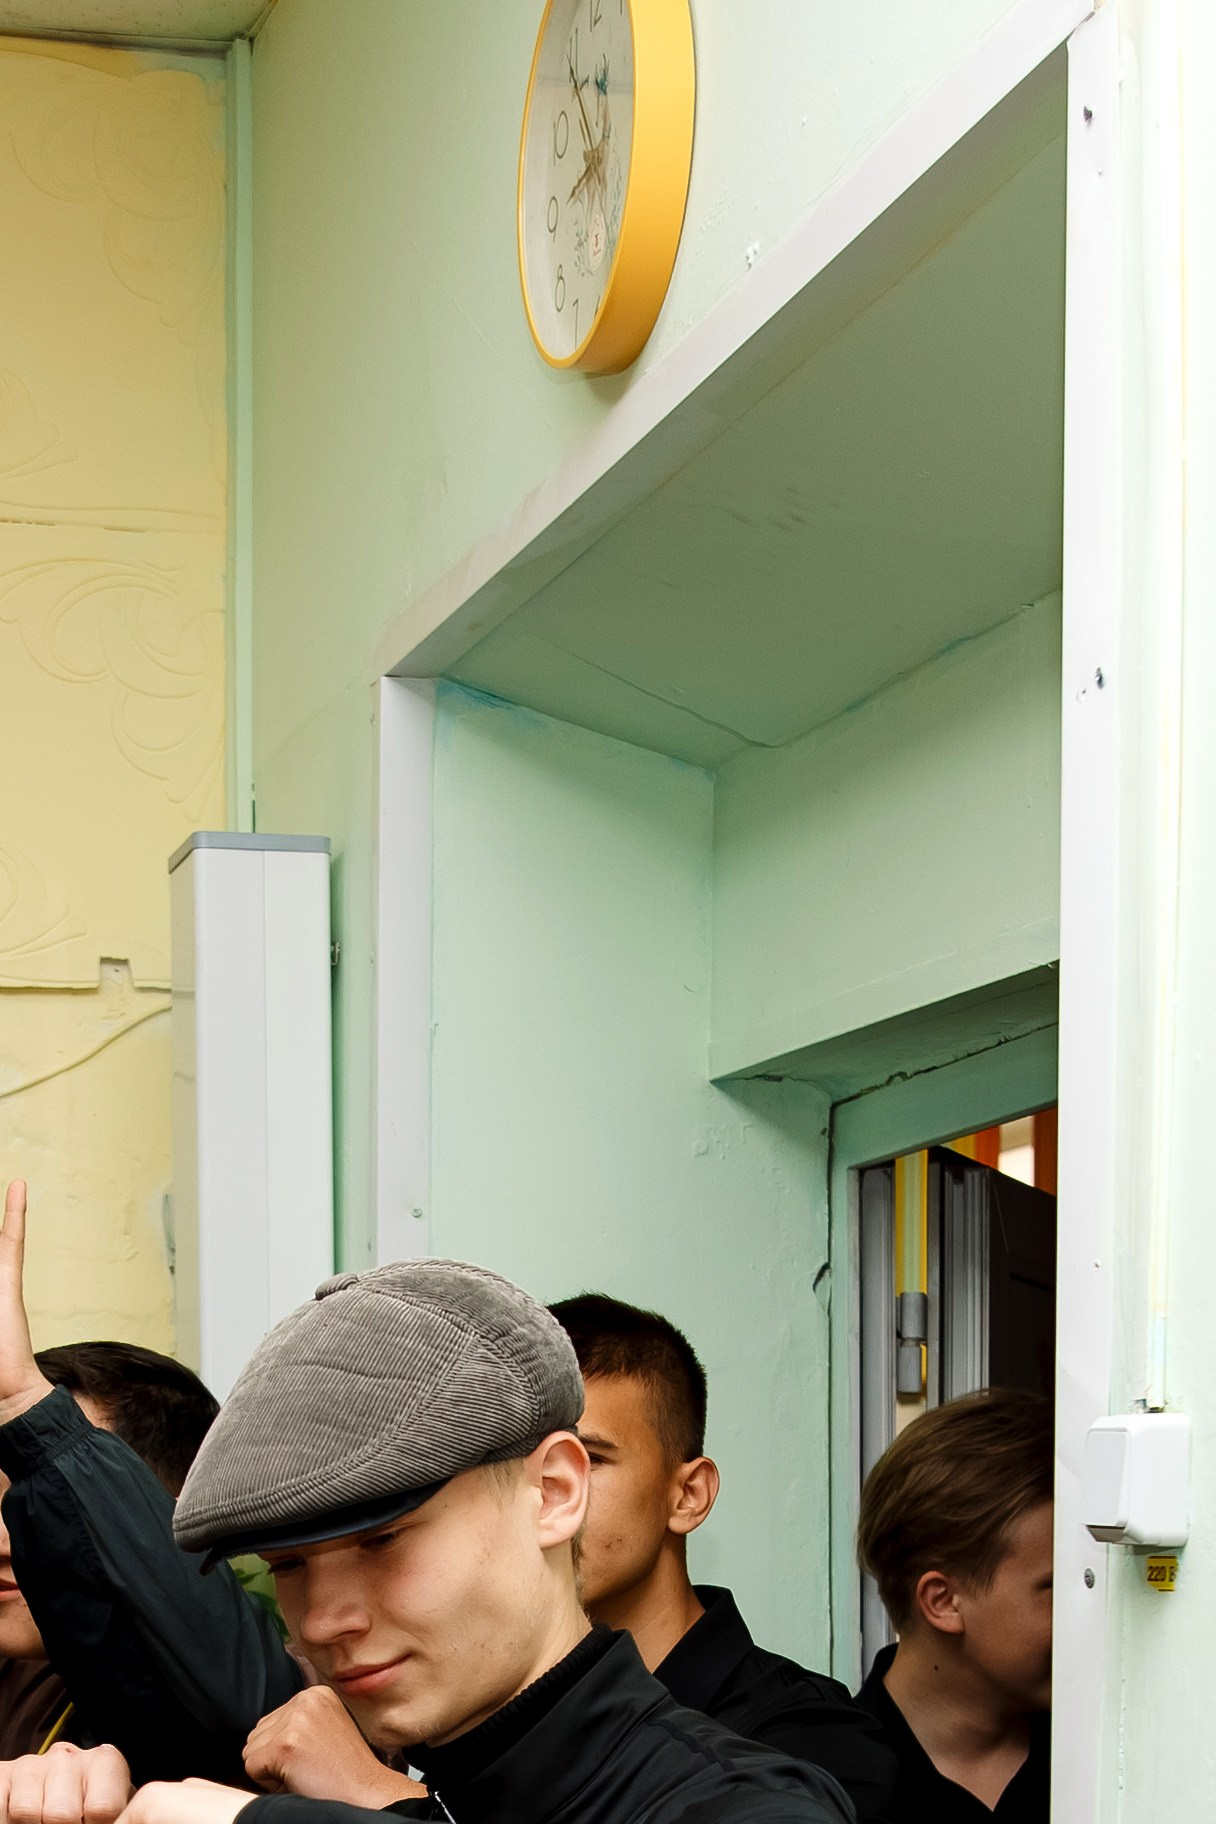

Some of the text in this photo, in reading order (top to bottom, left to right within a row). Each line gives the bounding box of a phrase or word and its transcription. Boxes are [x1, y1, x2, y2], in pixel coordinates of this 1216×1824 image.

[553, 110, 569, 167] 10
[547, 195, 559, 243] 9
[554, 263, 566, 313] 8
[1147, 1565, 1167, 1582] 220
